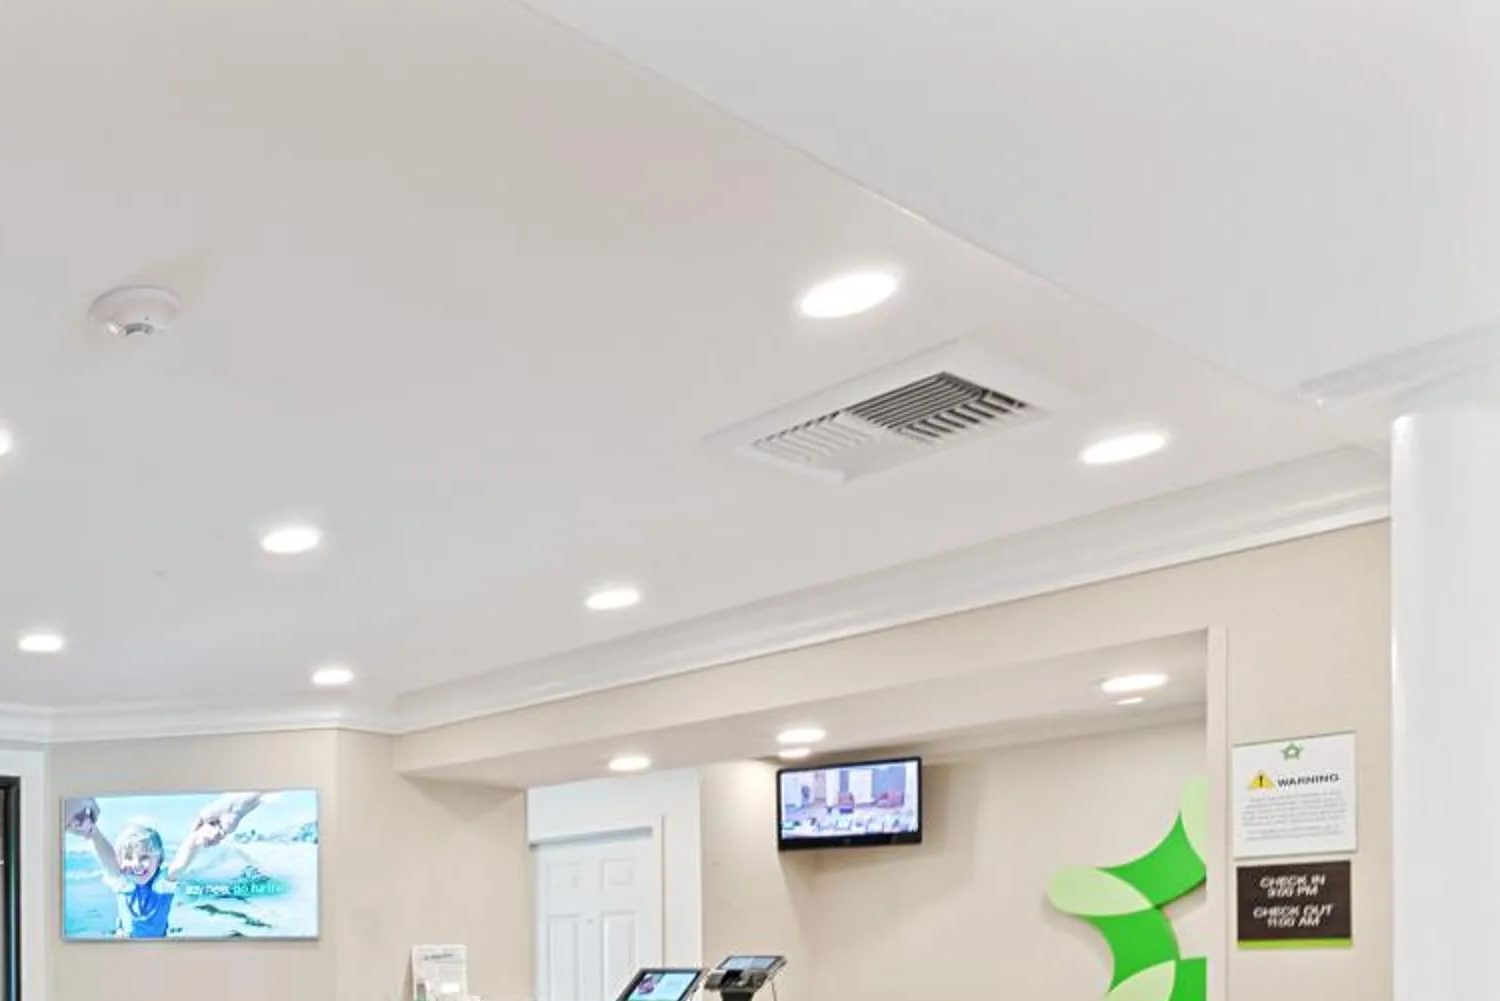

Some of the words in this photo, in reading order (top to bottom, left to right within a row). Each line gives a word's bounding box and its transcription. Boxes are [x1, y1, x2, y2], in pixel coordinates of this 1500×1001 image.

[1277, 773, 1339, 788] WARNING
[1260, 875, 1307, 889] CHECK
[1311, 874, 1326, 886] IN
[1297, 885, 1319, 896] PM
[1253, 905, 1300, 918] CHECK
[1303, 904, 1334, 917] OUT
[1298, 915, 1321, 927] AM
